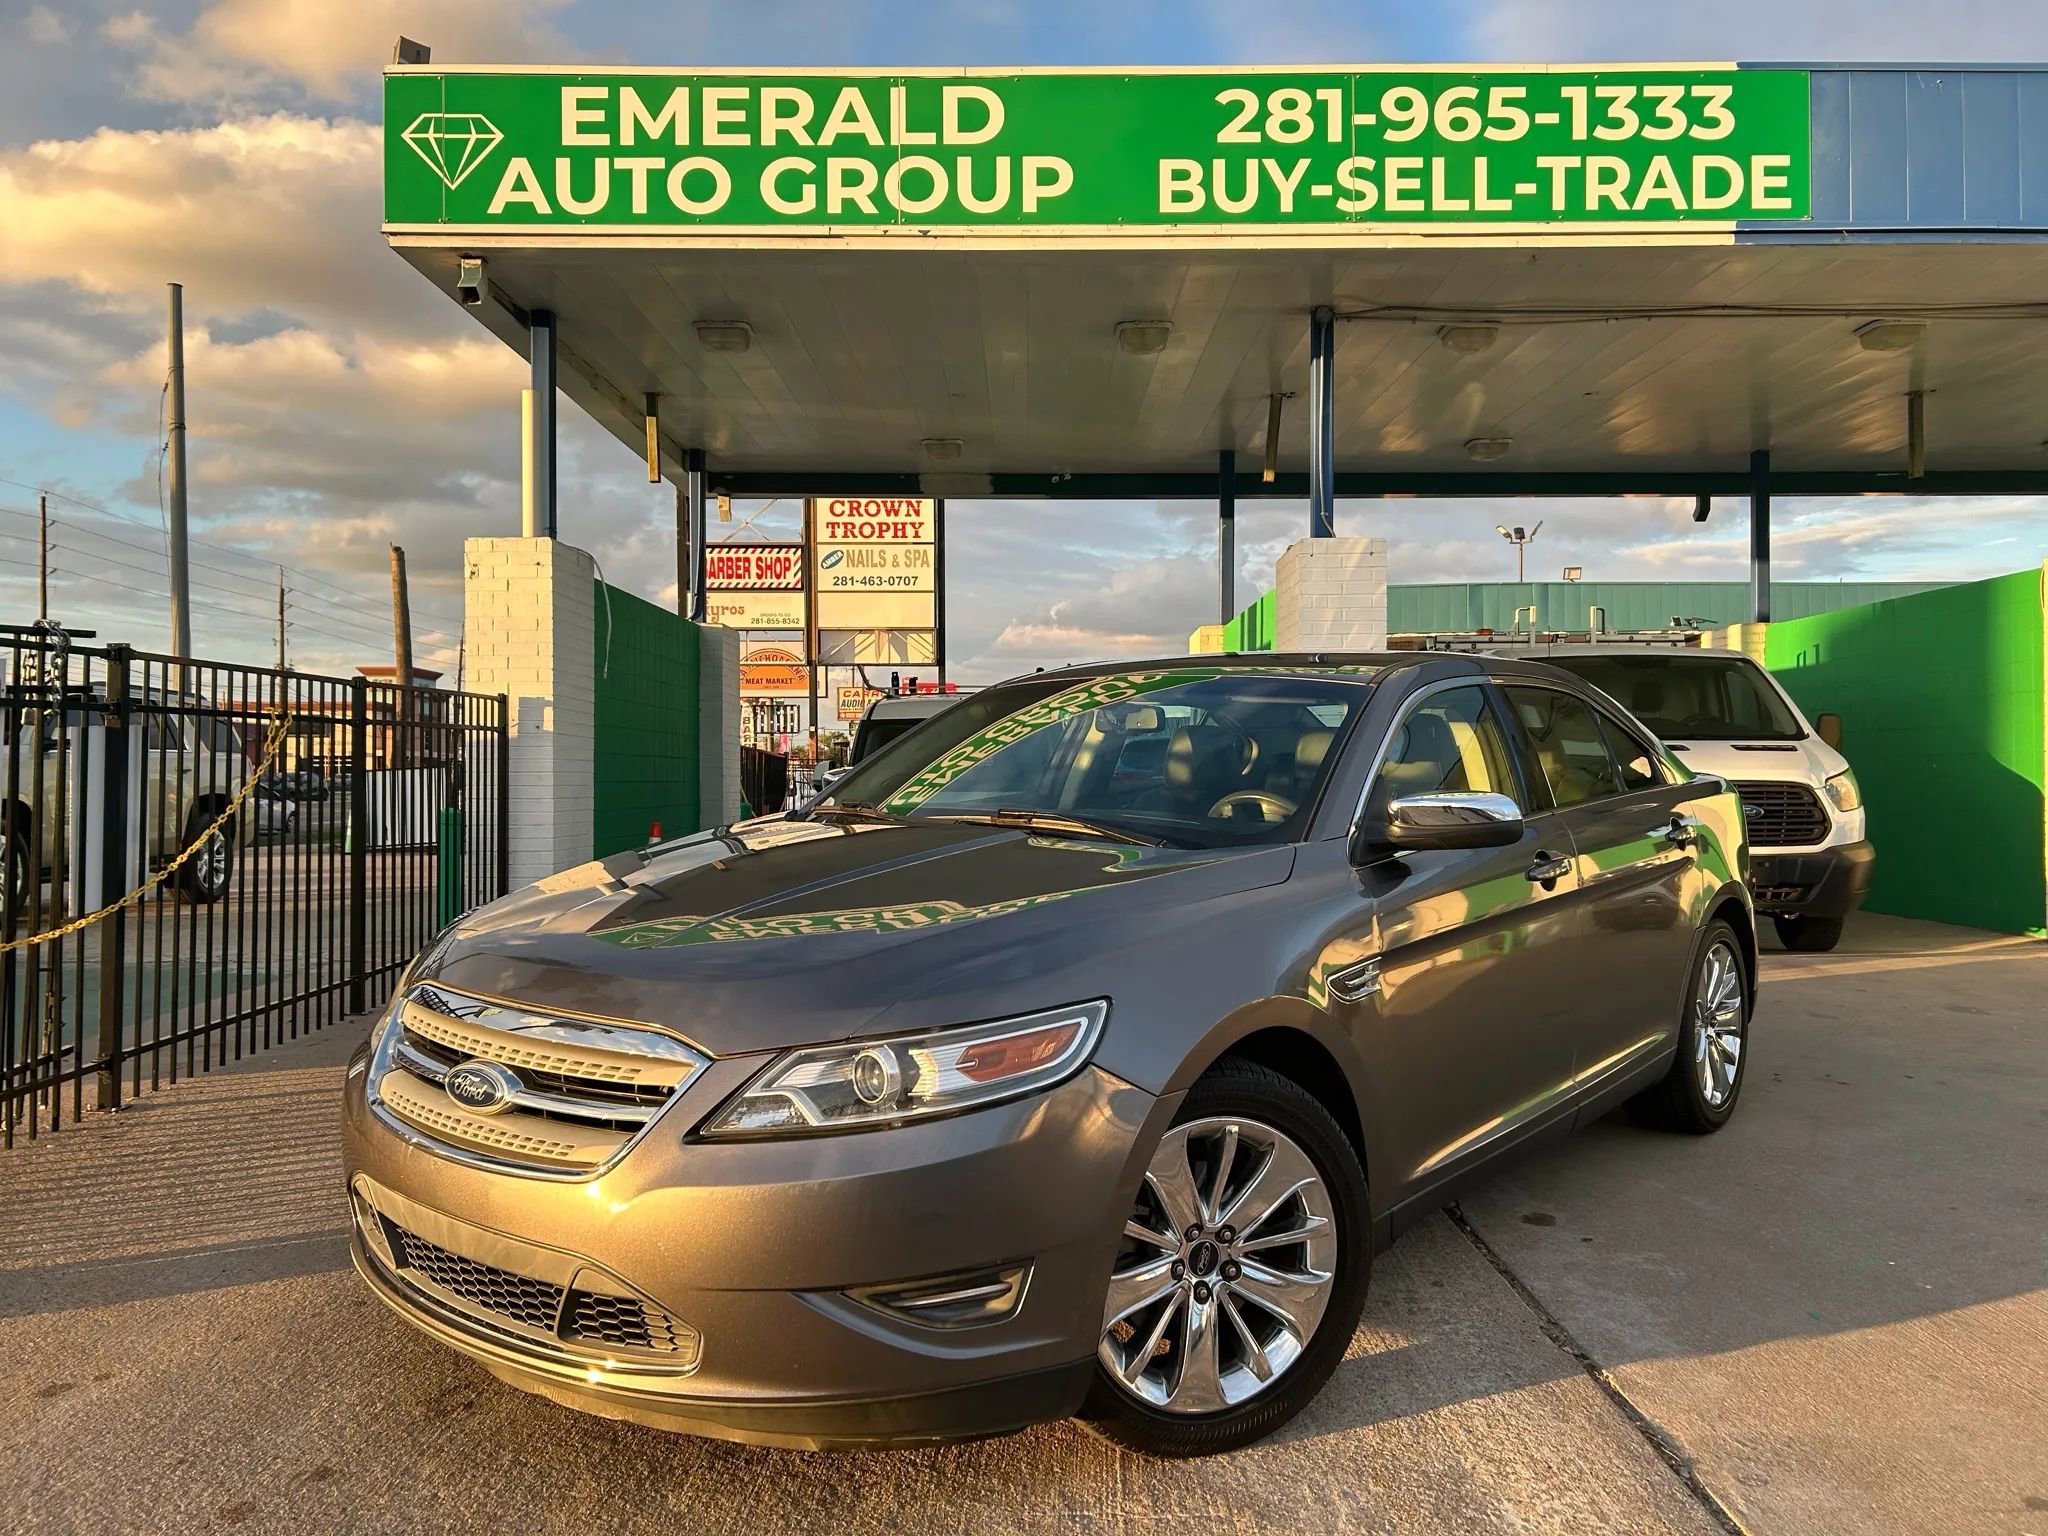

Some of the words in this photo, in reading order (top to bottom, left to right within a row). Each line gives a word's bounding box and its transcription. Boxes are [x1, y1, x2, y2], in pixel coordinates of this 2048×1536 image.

[561, 86, 1005, 146] EMERALD
[1215, 86, 1734, 143] 281-965-1333
[488, 157, 731, 214] AUTO
[759, 155, 1074, 215] GROUP
[1160, 155, 1791, 213] BUY-SELL-TRADE
[829, 500, 922, 517] CROWN
[826, 522, 924, 539] TROPHY
[706, 556, 751, 580] ARBER
[755, 556, 791, 580] SHOP
[822, 551, 844, 569] AMBER
[846, 549, 887, 568] NAILS
[892, 553, 900, 568] &
[904, 549, 930, 568] SPA
[832, 576, 919, 586] 281-463-0707
[751, 617, 800, 625] 281-855-8342
[454, 1073, 487, 1100] Ford
